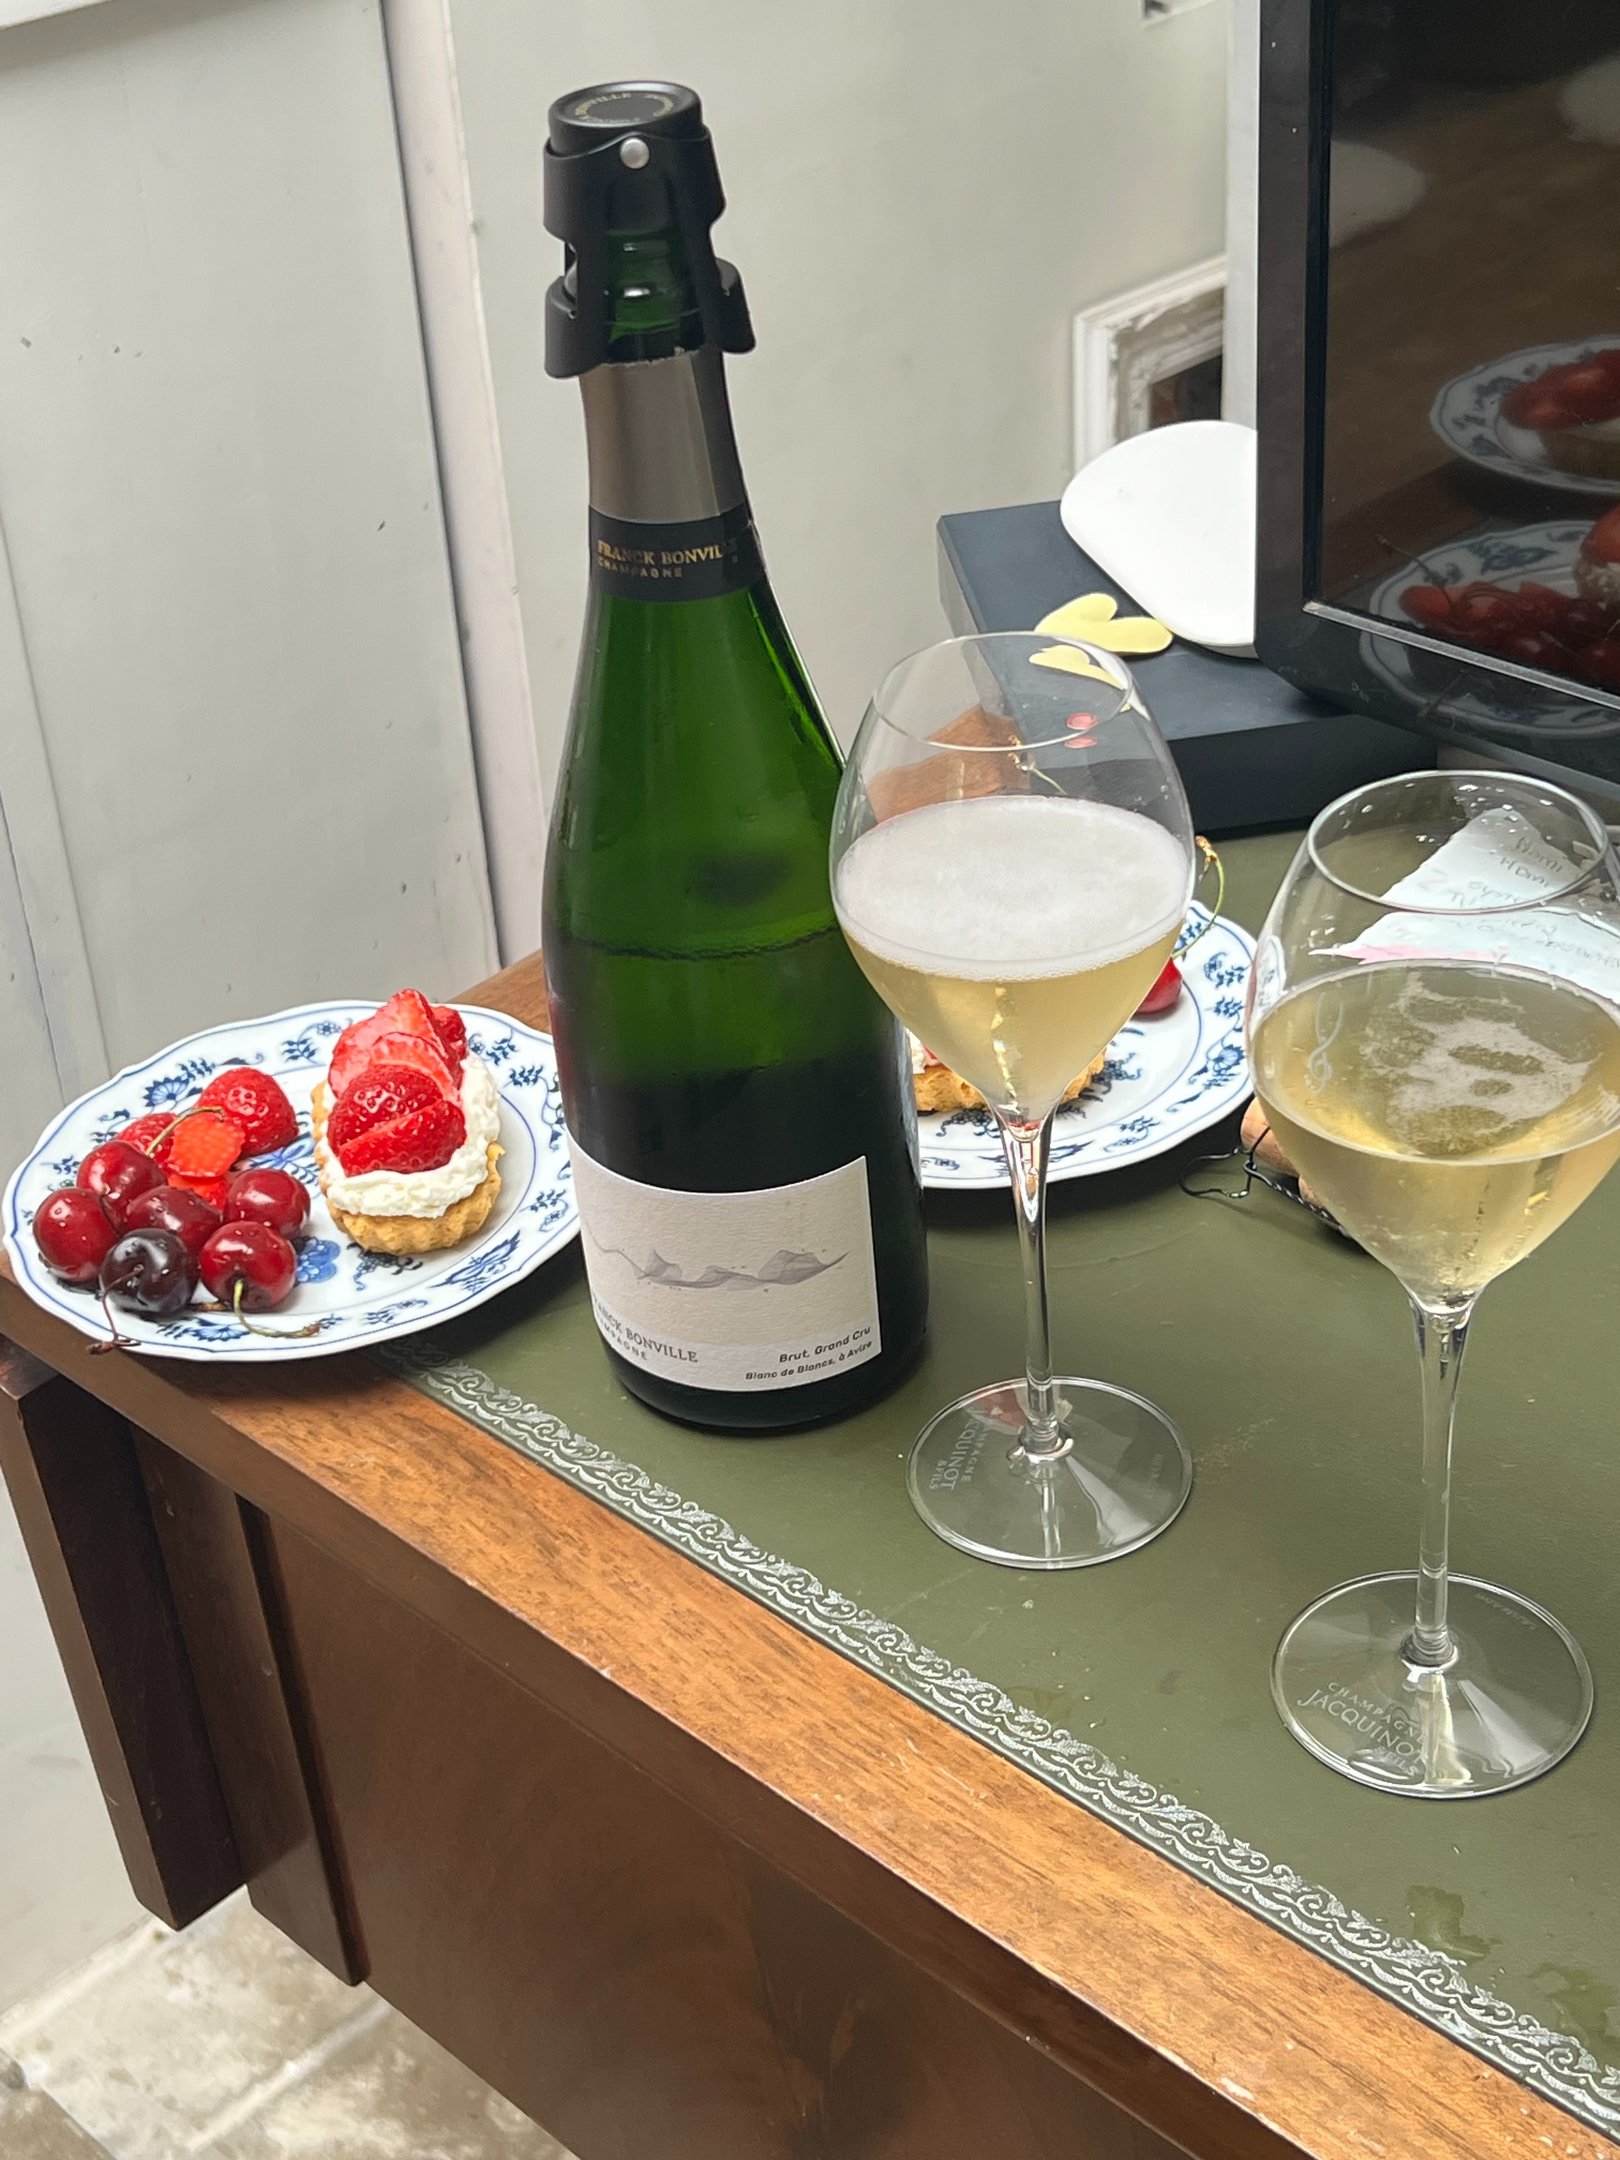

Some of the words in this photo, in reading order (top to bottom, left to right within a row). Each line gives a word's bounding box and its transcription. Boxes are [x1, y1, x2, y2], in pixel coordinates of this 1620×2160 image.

[597, 539, 655, 566] FRANCK
[625, 1327, 699, 1363] BONVILLE
[814, 1335, 850, 1355] Grand
[852, 1326, 872, 1341] Cru
[745, 1371, 778, 1380] Blanc
[780, 1367, 795, 1377] de
[838, 1352, 846, 1362] à
[846, 1340, 873, 1358] Avize
[1297, 1689, 1426, 1764] JACQUINOT
[1328, 1682, 1424, 1744] CHAMPAGNE
